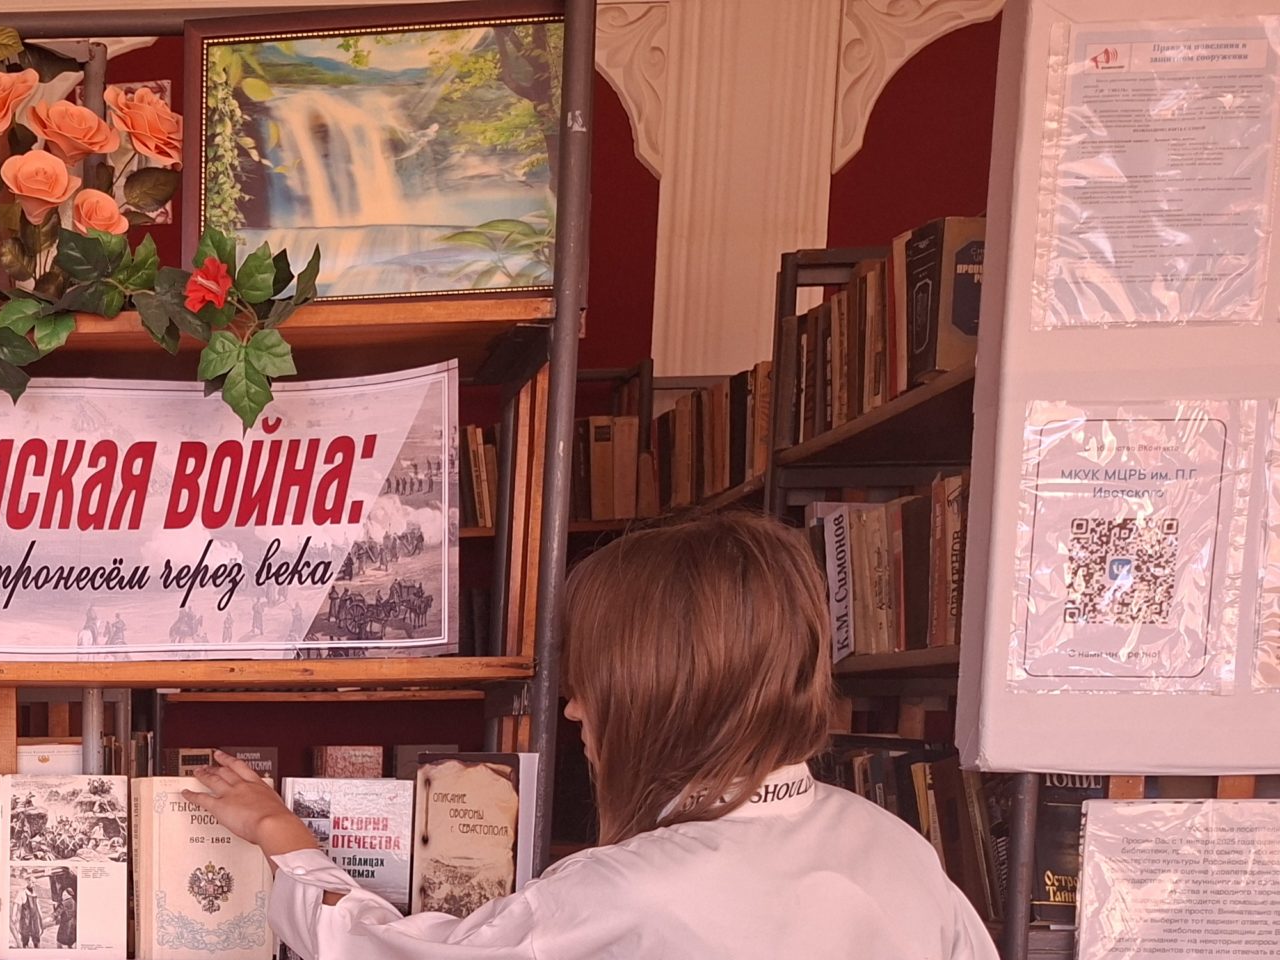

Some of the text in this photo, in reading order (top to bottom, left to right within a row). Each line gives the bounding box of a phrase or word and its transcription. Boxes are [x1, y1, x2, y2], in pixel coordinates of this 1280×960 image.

[1194, 43, 1238, 51] поведения
[1196, 53, 1248, 62] сооружении
[163, 416, 378, 531] война:
[1061, 469, 1100, 480] МКУК
[1151, 472, 1171, 480] им.
[832, 512, 848, 603] Симонов
[161, 540, 244, 611] через
[253, 537, 335, 586] века
[433, 793, 467, 804] ОПИСАНИЕ
[449, 809, 484, 819] ОБОРОНЫ
[332, 816, 388, 831] ИСТОРИЯ
[458, 824, 508, 836] СЕВАСТОПОЛЯ
[332, 834, 400, 849] ОТЕЧЕСТВА
[342, 856, 384, 867] таблицах
[346, 869, 375, 878] хемах
